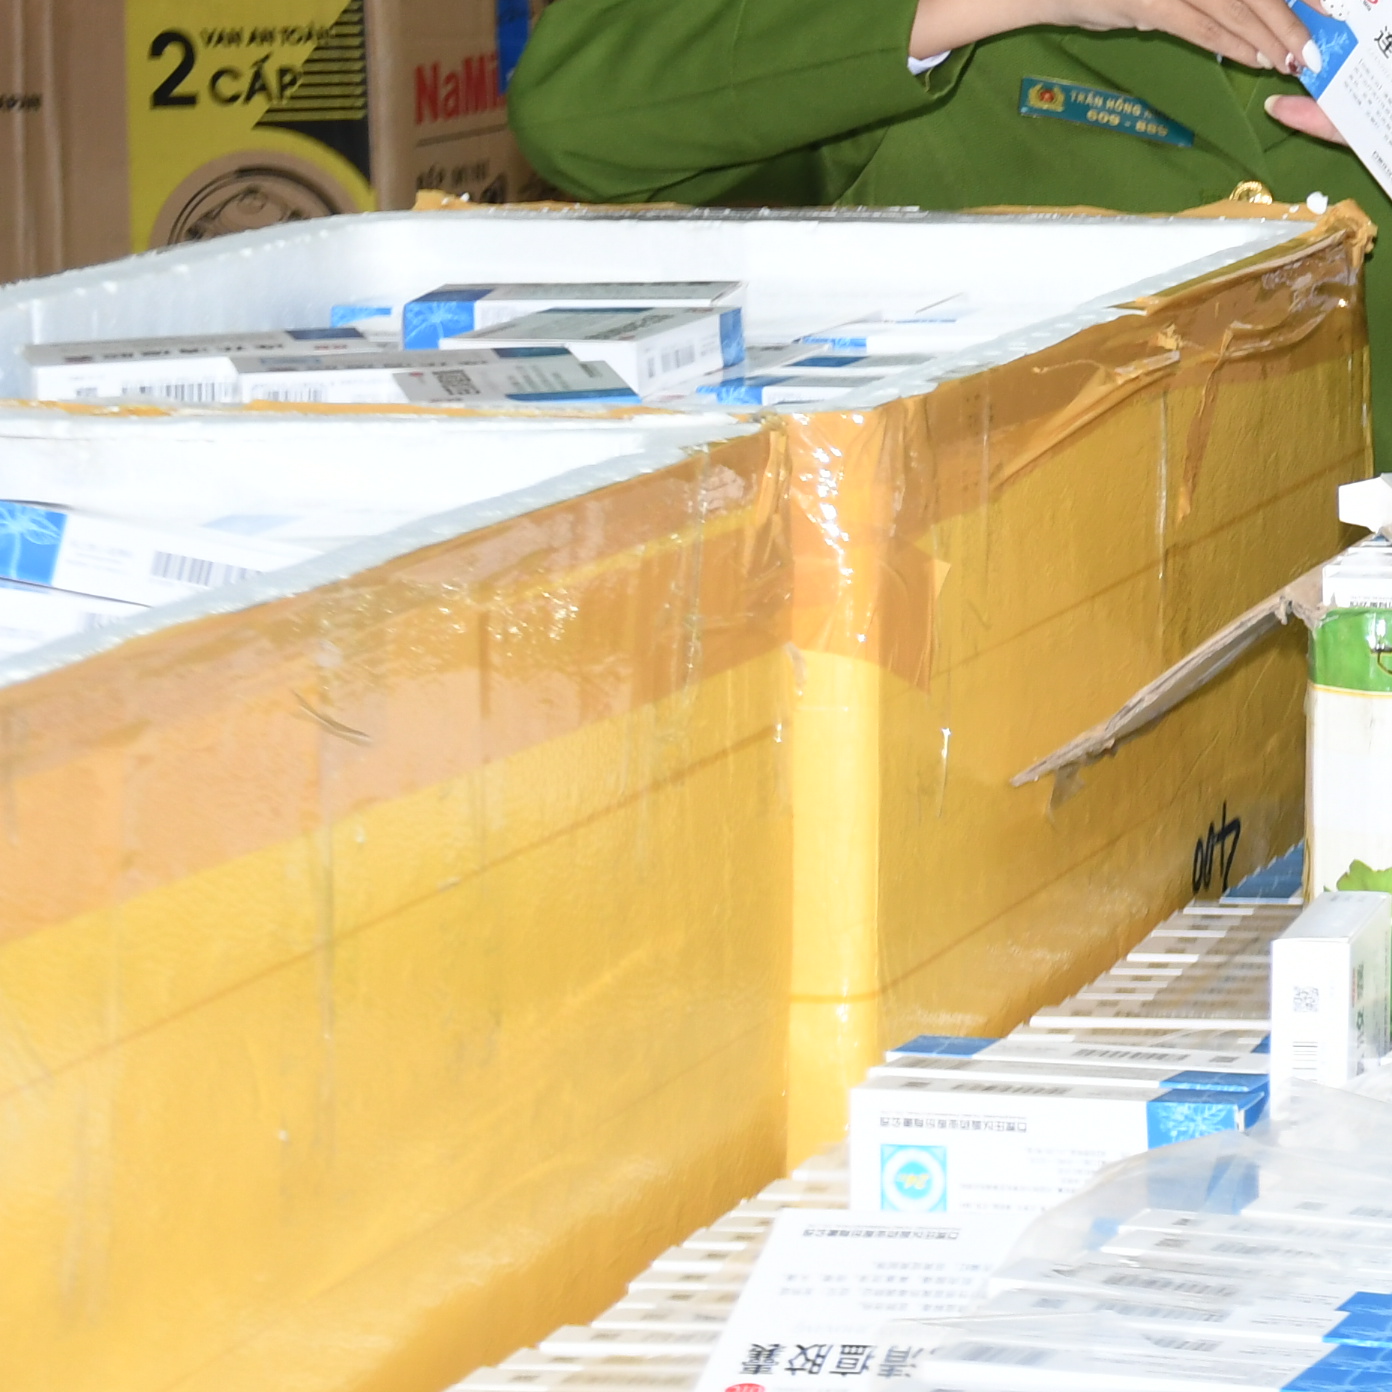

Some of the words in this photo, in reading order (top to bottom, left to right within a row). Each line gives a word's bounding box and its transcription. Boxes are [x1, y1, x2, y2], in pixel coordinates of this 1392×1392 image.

[148, 27, 198, 110] 2
[208, 51, 303, 107] CẤP
[415, 53, 508, 125] NaMi
